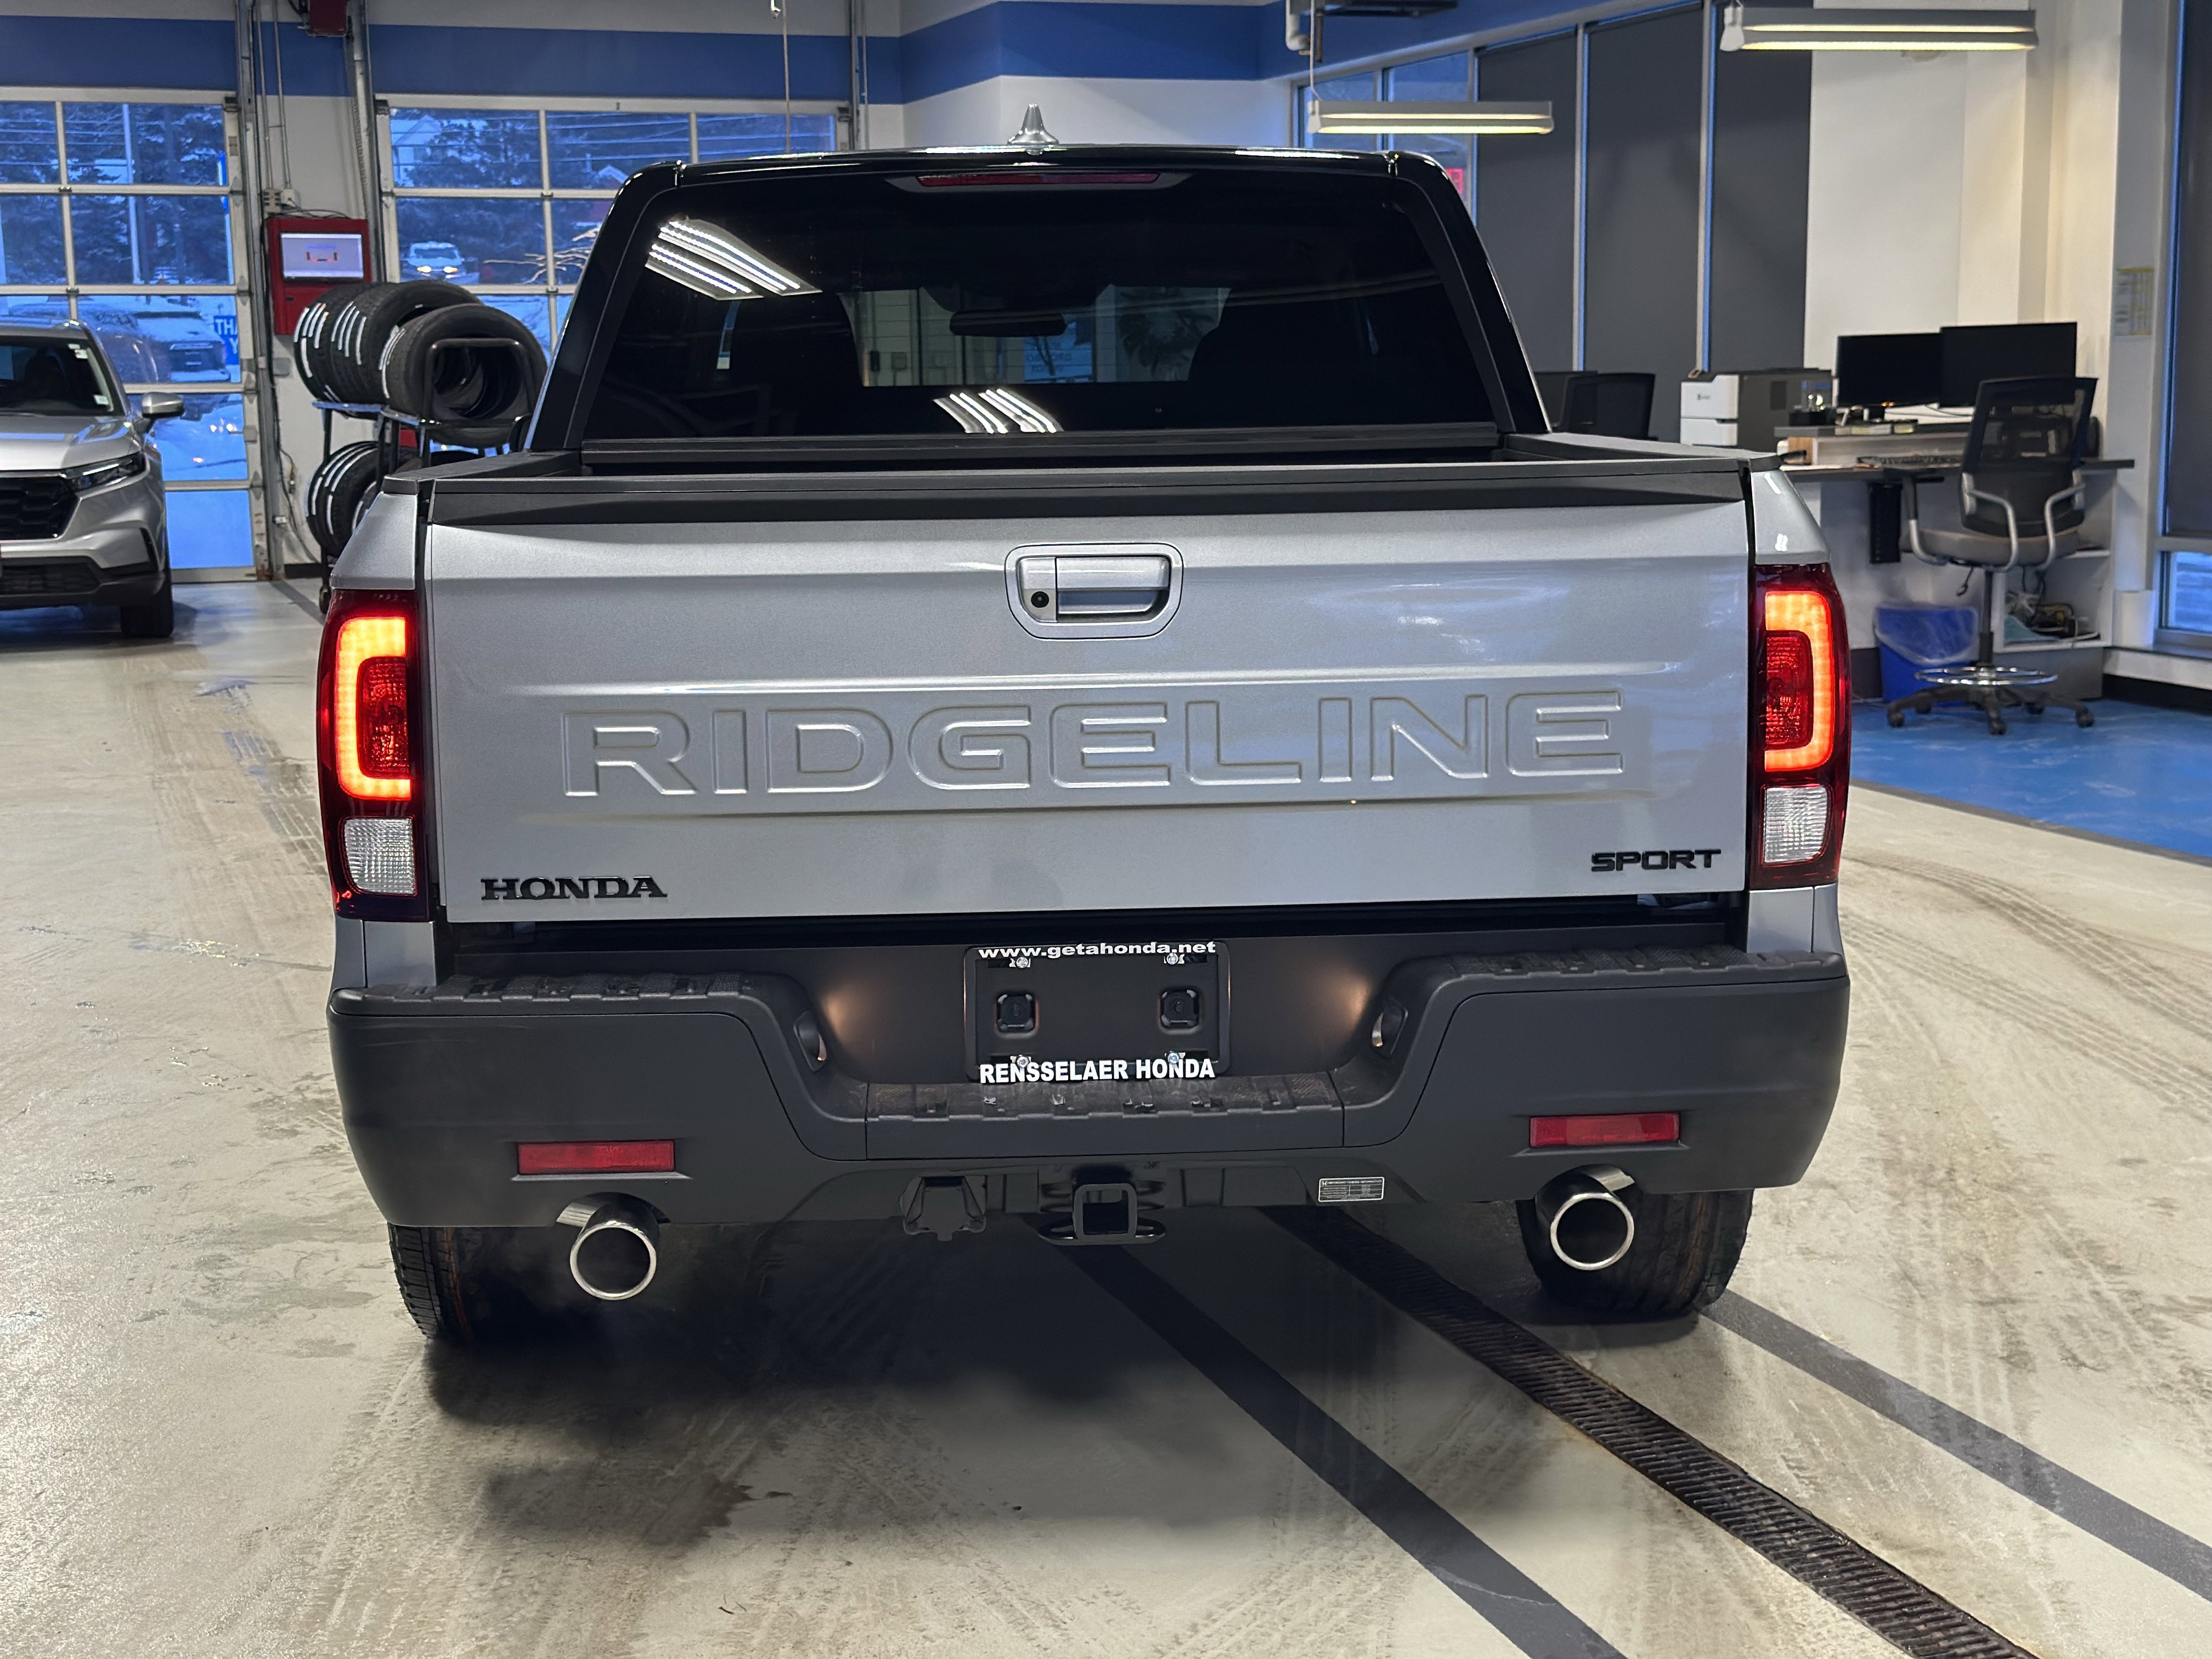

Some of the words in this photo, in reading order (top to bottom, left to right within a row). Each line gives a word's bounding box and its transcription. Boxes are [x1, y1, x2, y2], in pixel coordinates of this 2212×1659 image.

[562, 690, 1623, 797] RIDGELINE
[1591, 849, 1722, 872] SPORT
[481, 876, 668, 900] HONDA
[978, 941, 1216, 959] www.getahonda.net
[979, 1060, 1128, 1084] RENSSELAER
[1136, 1058, 1215, 1079] HONDA
